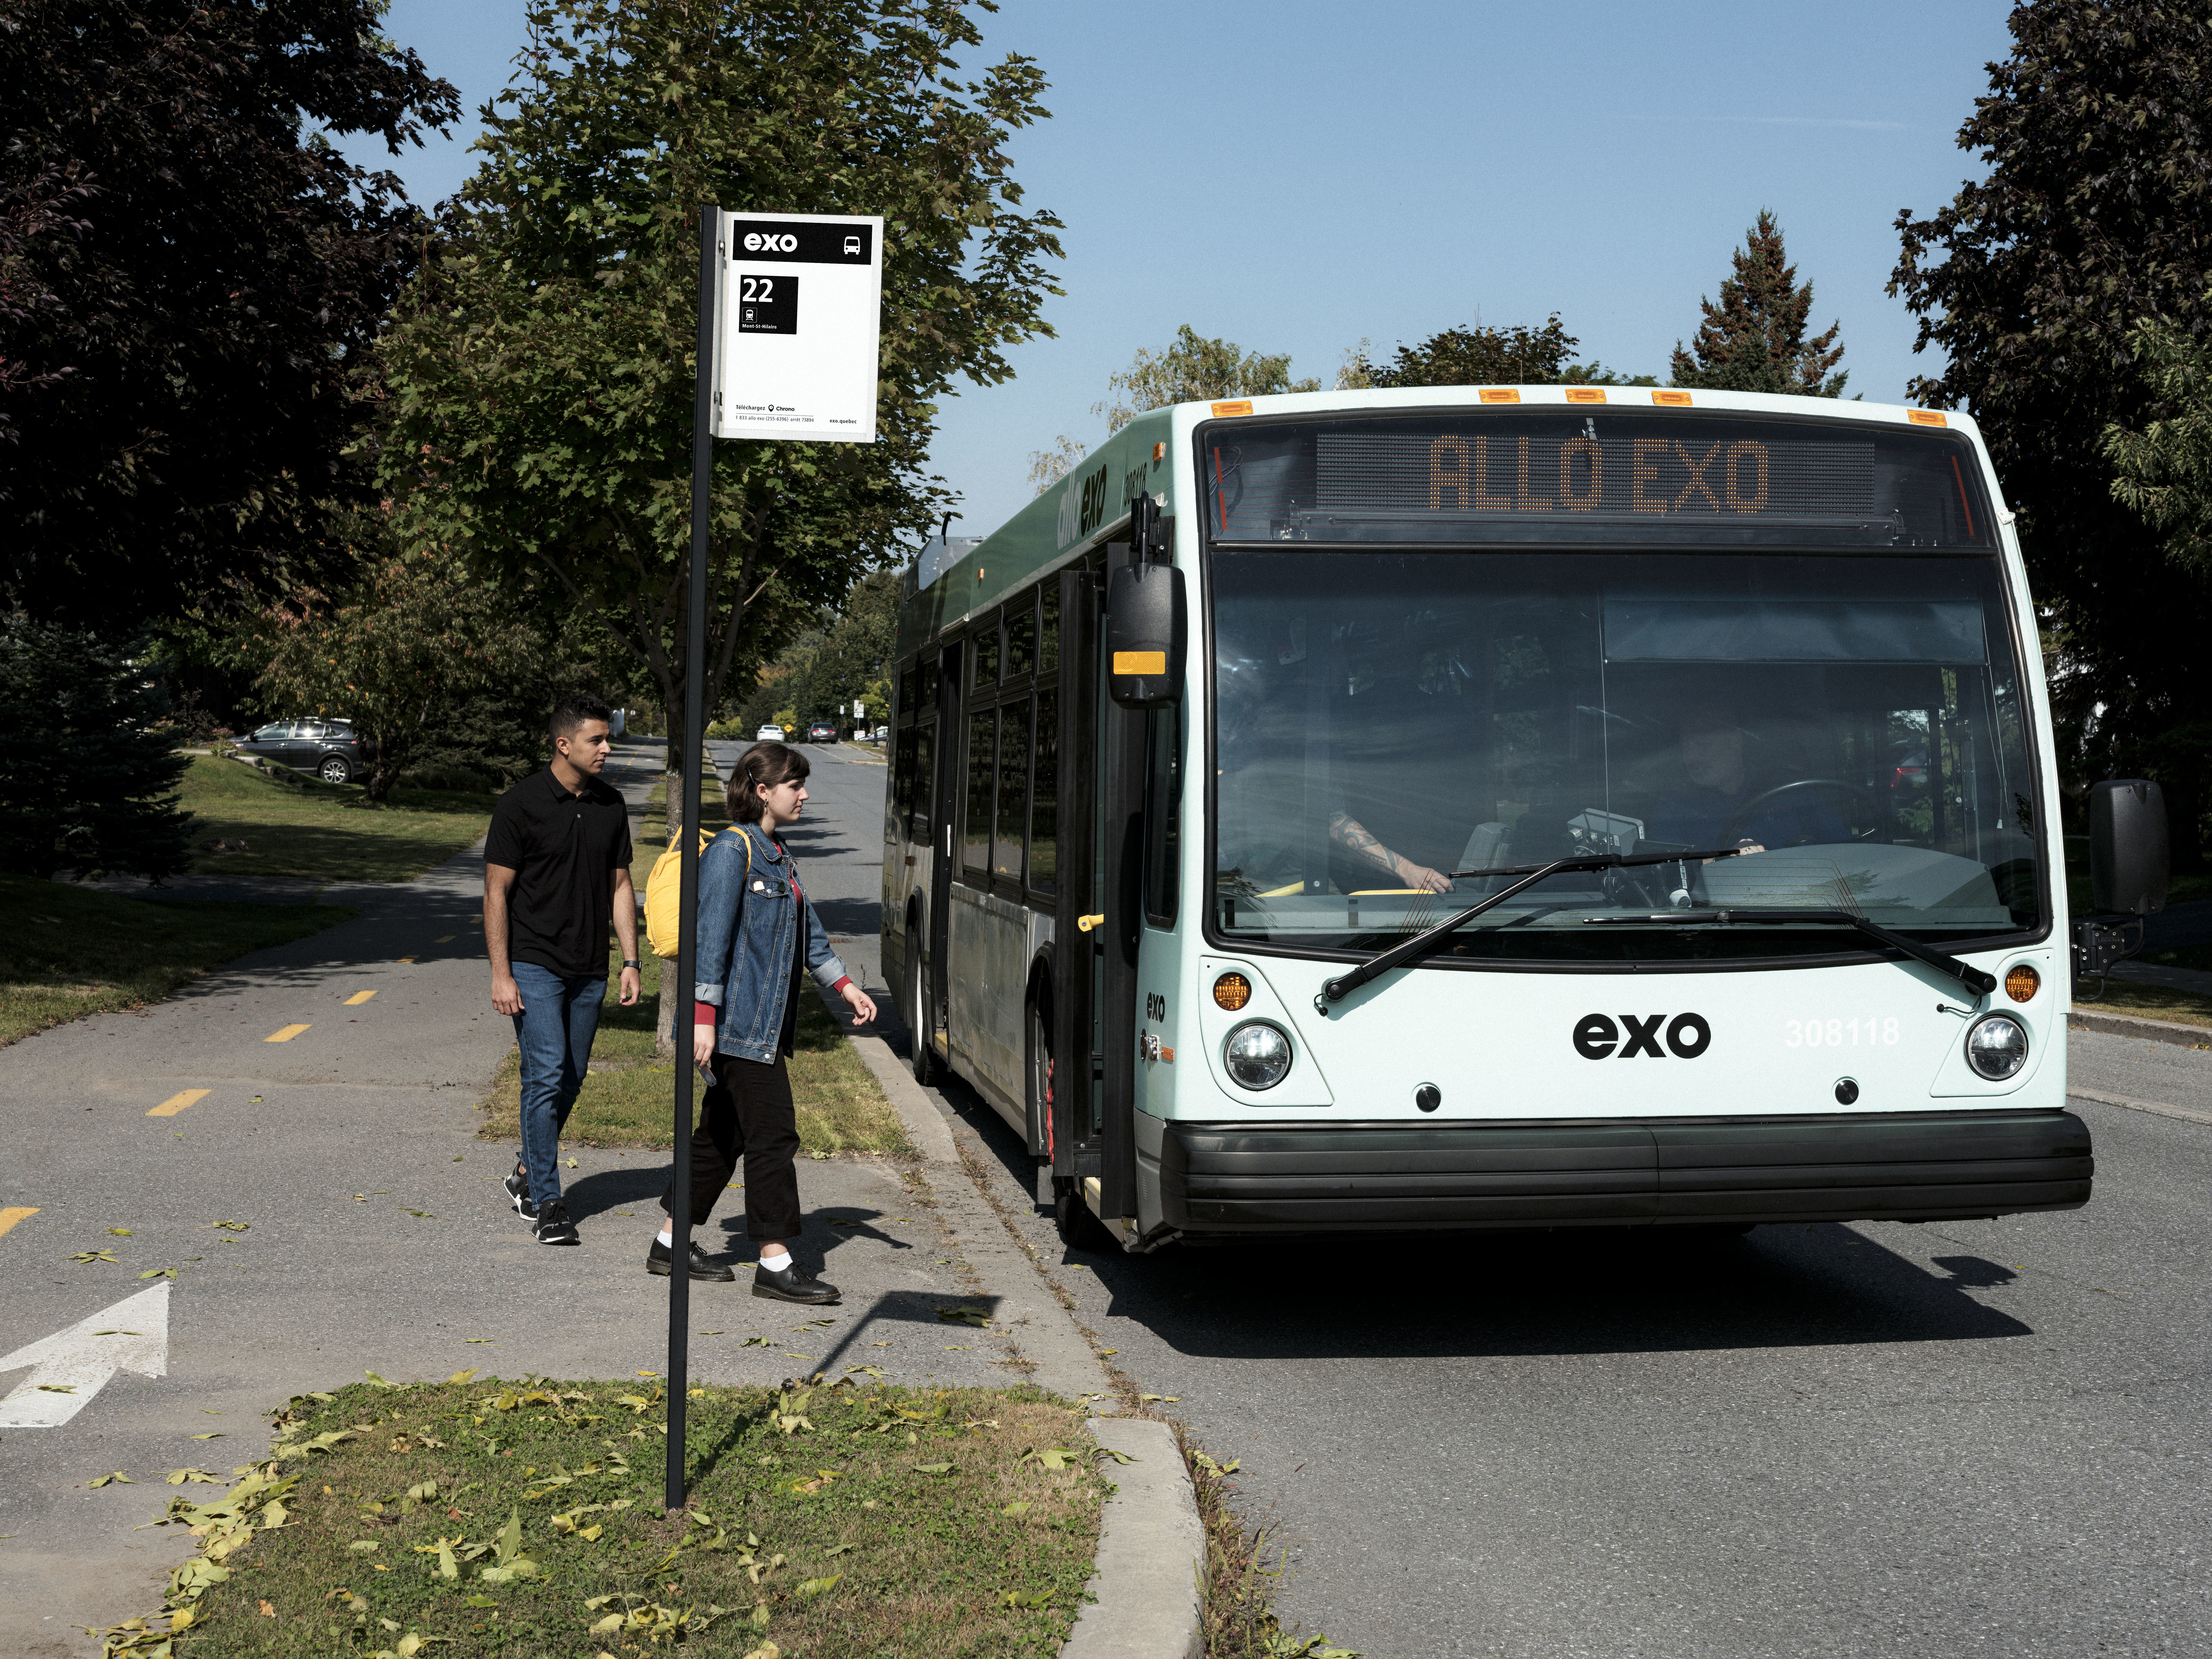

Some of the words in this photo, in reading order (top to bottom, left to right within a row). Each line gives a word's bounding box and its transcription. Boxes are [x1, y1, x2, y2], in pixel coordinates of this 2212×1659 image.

[744, 233, 798, 252] exo
[742, 278, 773, 302] 22
[1124, 462, 1147, 507] 308118
[1430, 435, 1602, 511] ALLO
[1634, 438, 1768, 513] EXO
[1147, 992, 1165, 1023] exo
[1573, 1012, 1711, 1060] exo
[1785, 1017, 1900, 1048] 308118
